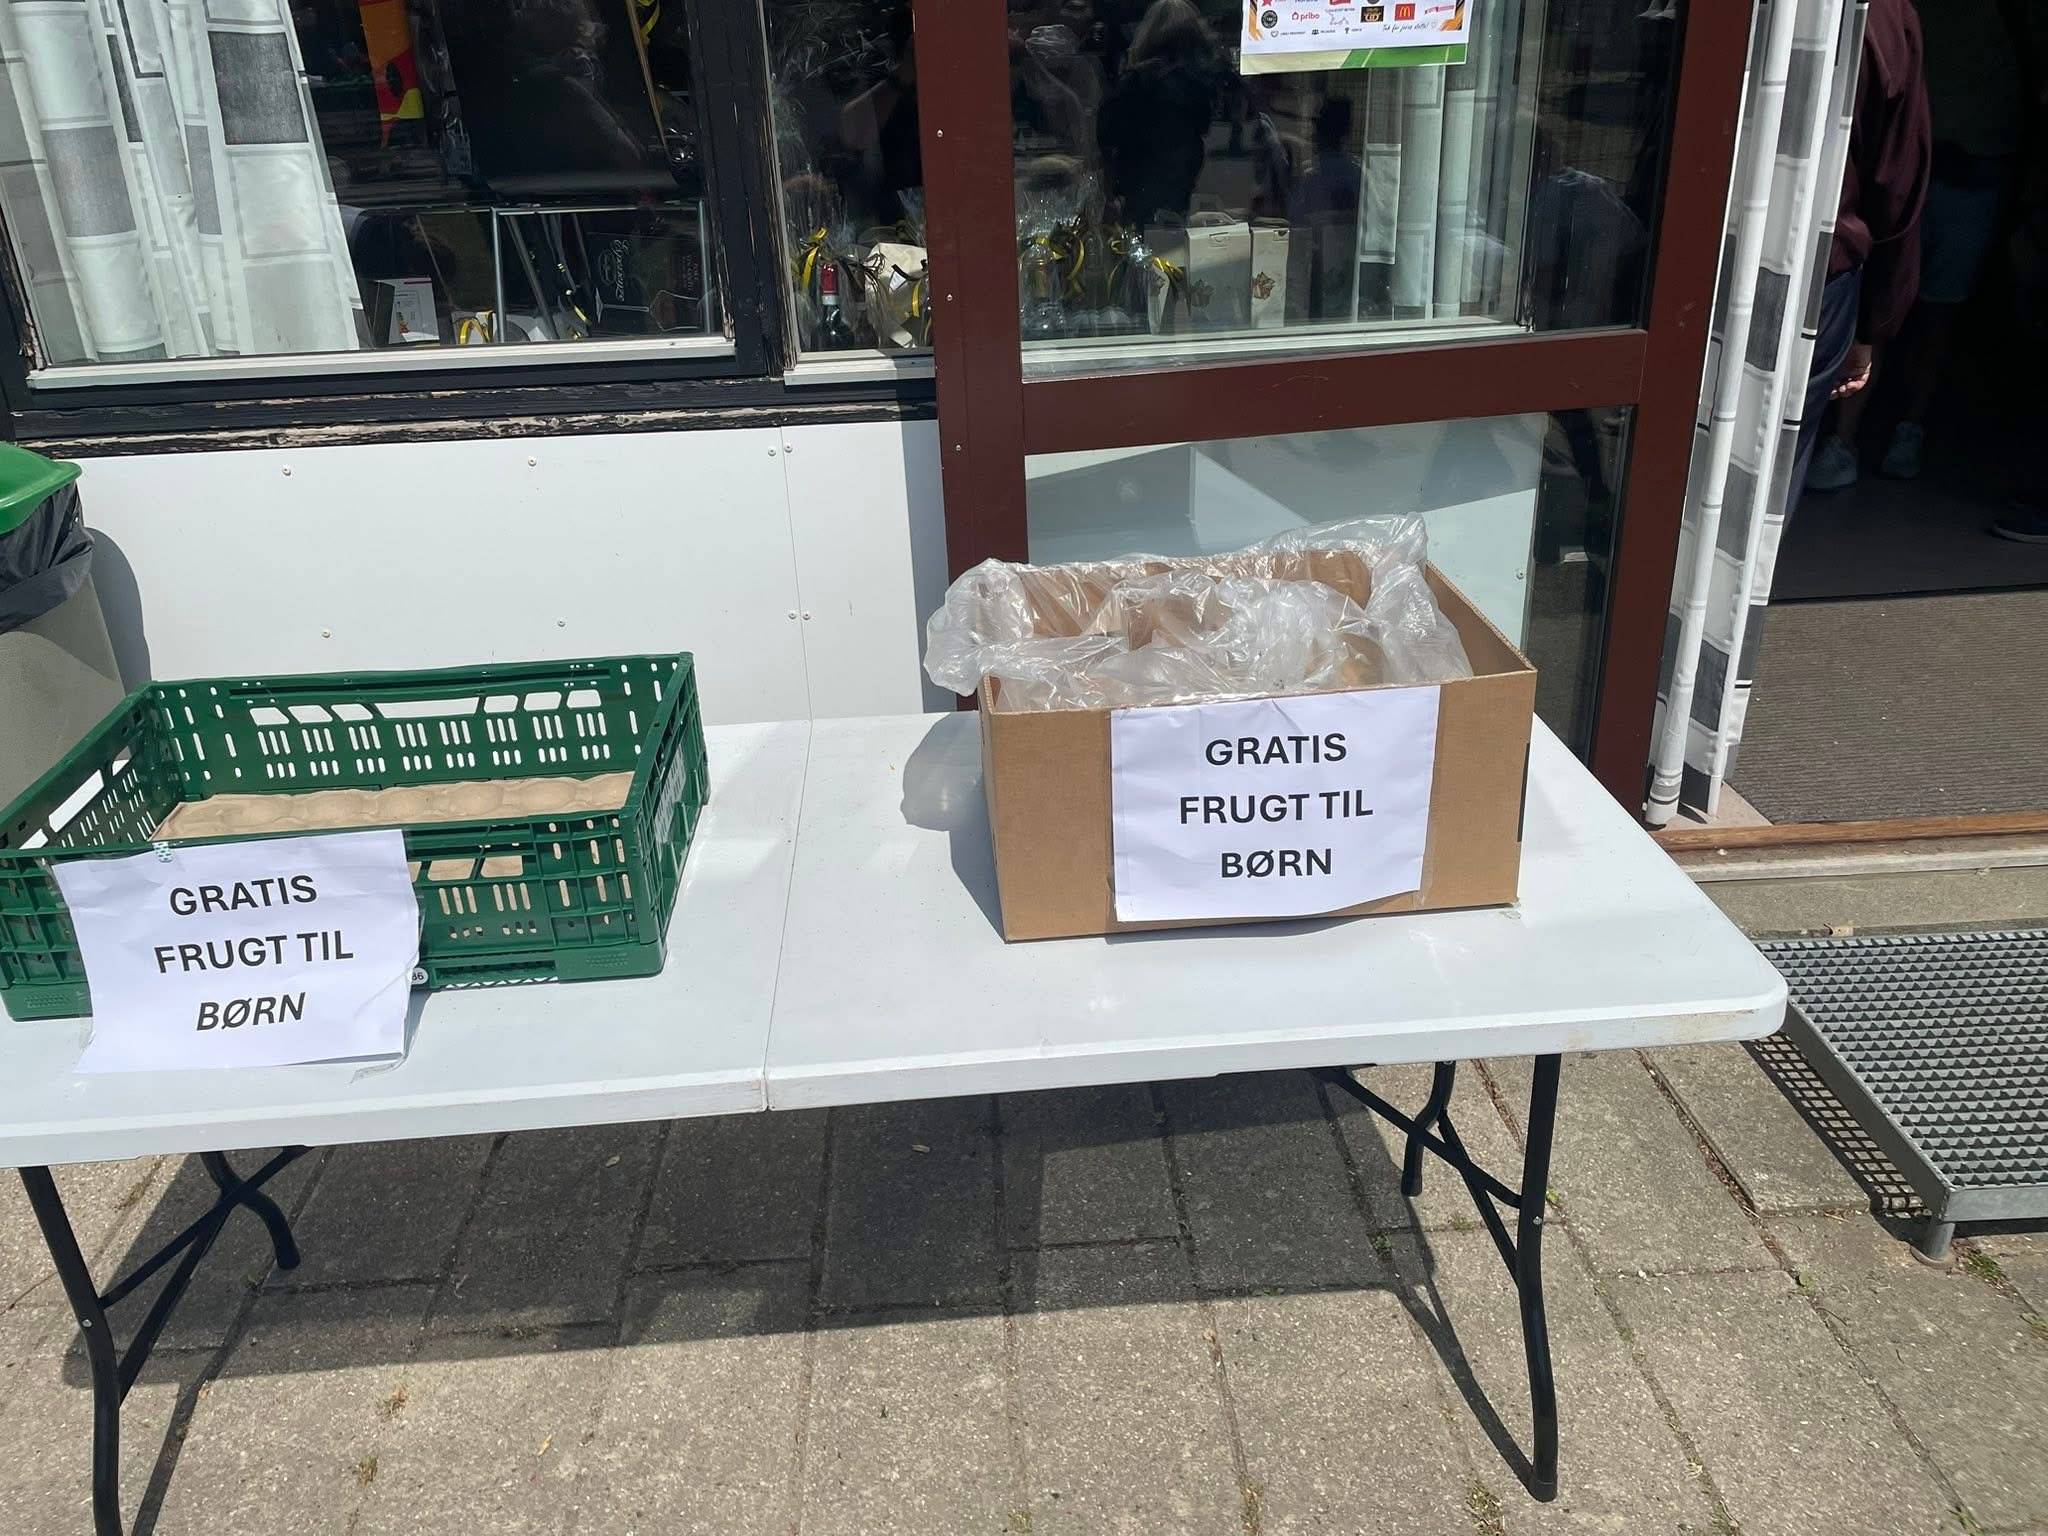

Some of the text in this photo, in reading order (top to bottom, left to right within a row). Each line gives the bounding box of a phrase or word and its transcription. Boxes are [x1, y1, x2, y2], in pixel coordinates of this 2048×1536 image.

[1300, 12, 1320, 22] pribo
[1206, 733, 1347, 766] GRATIS
[1181, 790, 1374, 825] FRUGT TIL
[1221, 848, 1332, 879] BØRN
[170, 875, 317, 916] GRATIS
[155, 930, 354, 974] FRUGT TIL
[196, 992, 306, 1031] BØRN
